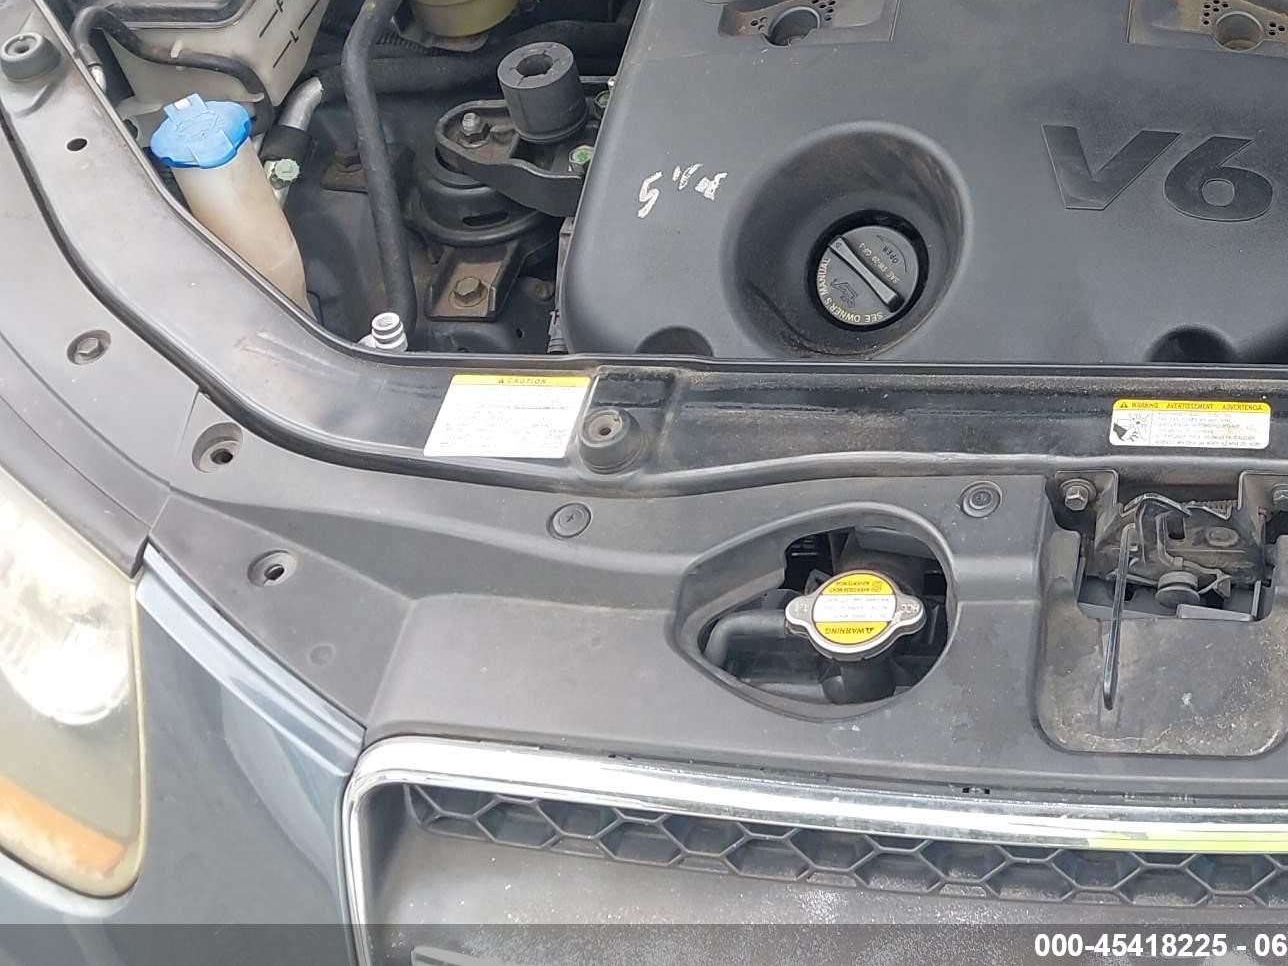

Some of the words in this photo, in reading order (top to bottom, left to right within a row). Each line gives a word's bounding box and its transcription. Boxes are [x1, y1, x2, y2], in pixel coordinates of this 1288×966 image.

[289, 29, 300, 44] L
[1041, 122, 1274, 223] V6
[817, 257, 832, 296] MANUAL
[824, 296, 861, 323] OWNER'S
[864, 310, 885, 323] SEE
[507, 377, 547, 385] CAUTION
[1131, 401, 1159, 410] WARNING
[1166, 402, 1215, 411] AVERTISSEMENT
[1222, 403, 1263, 412] ADVERTENCIA
[824, 626, 867, 635] WARNING
